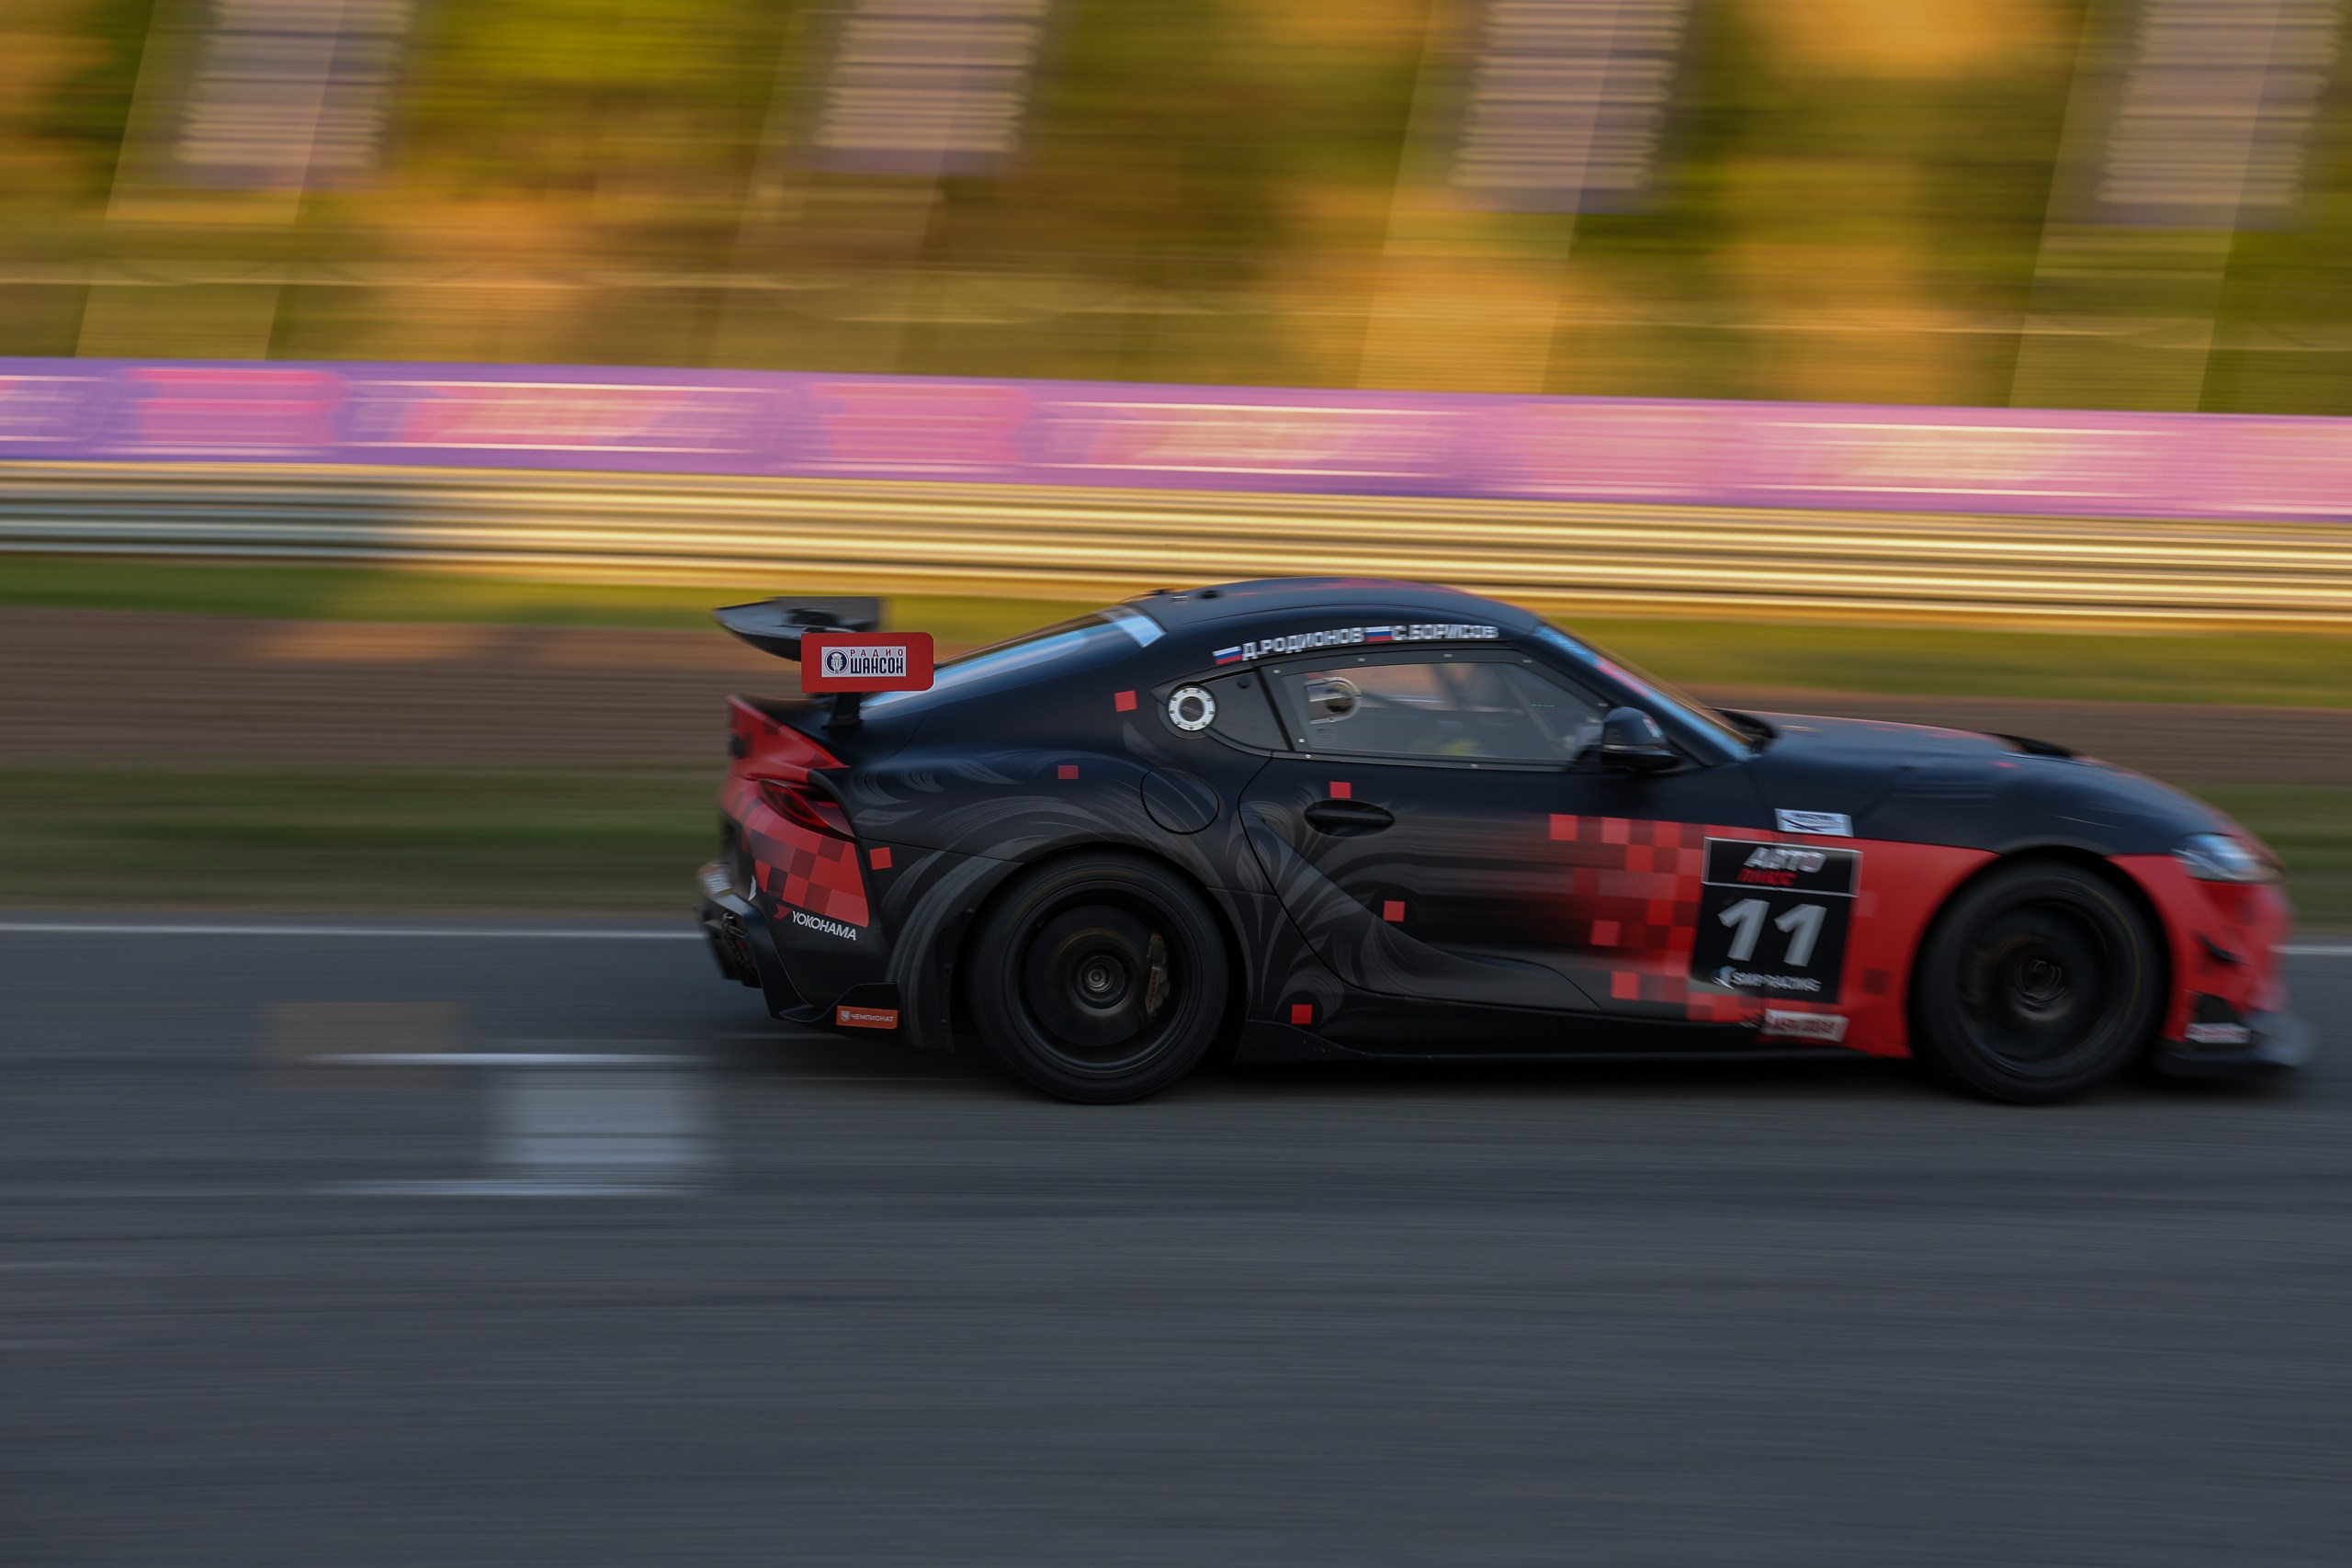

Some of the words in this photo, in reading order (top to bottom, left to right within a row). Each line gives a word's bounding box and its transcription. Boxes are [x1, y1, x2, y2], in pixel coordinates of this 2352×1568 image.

[1391, 624, 1499, 640] С.БОРИСОВ
[1242, 626, 1365, 660] Д.РОДИОНОВ
[851, 649, 903, 658] РАДИО
[850, 657, 903, 673] ШАНСОН
[792, 910, 856, 942] YOKOHAMA
[1717, 897, 1827, 967] 11
[850, 1013, 895, 1022] ЧЕМПИОНАТ
